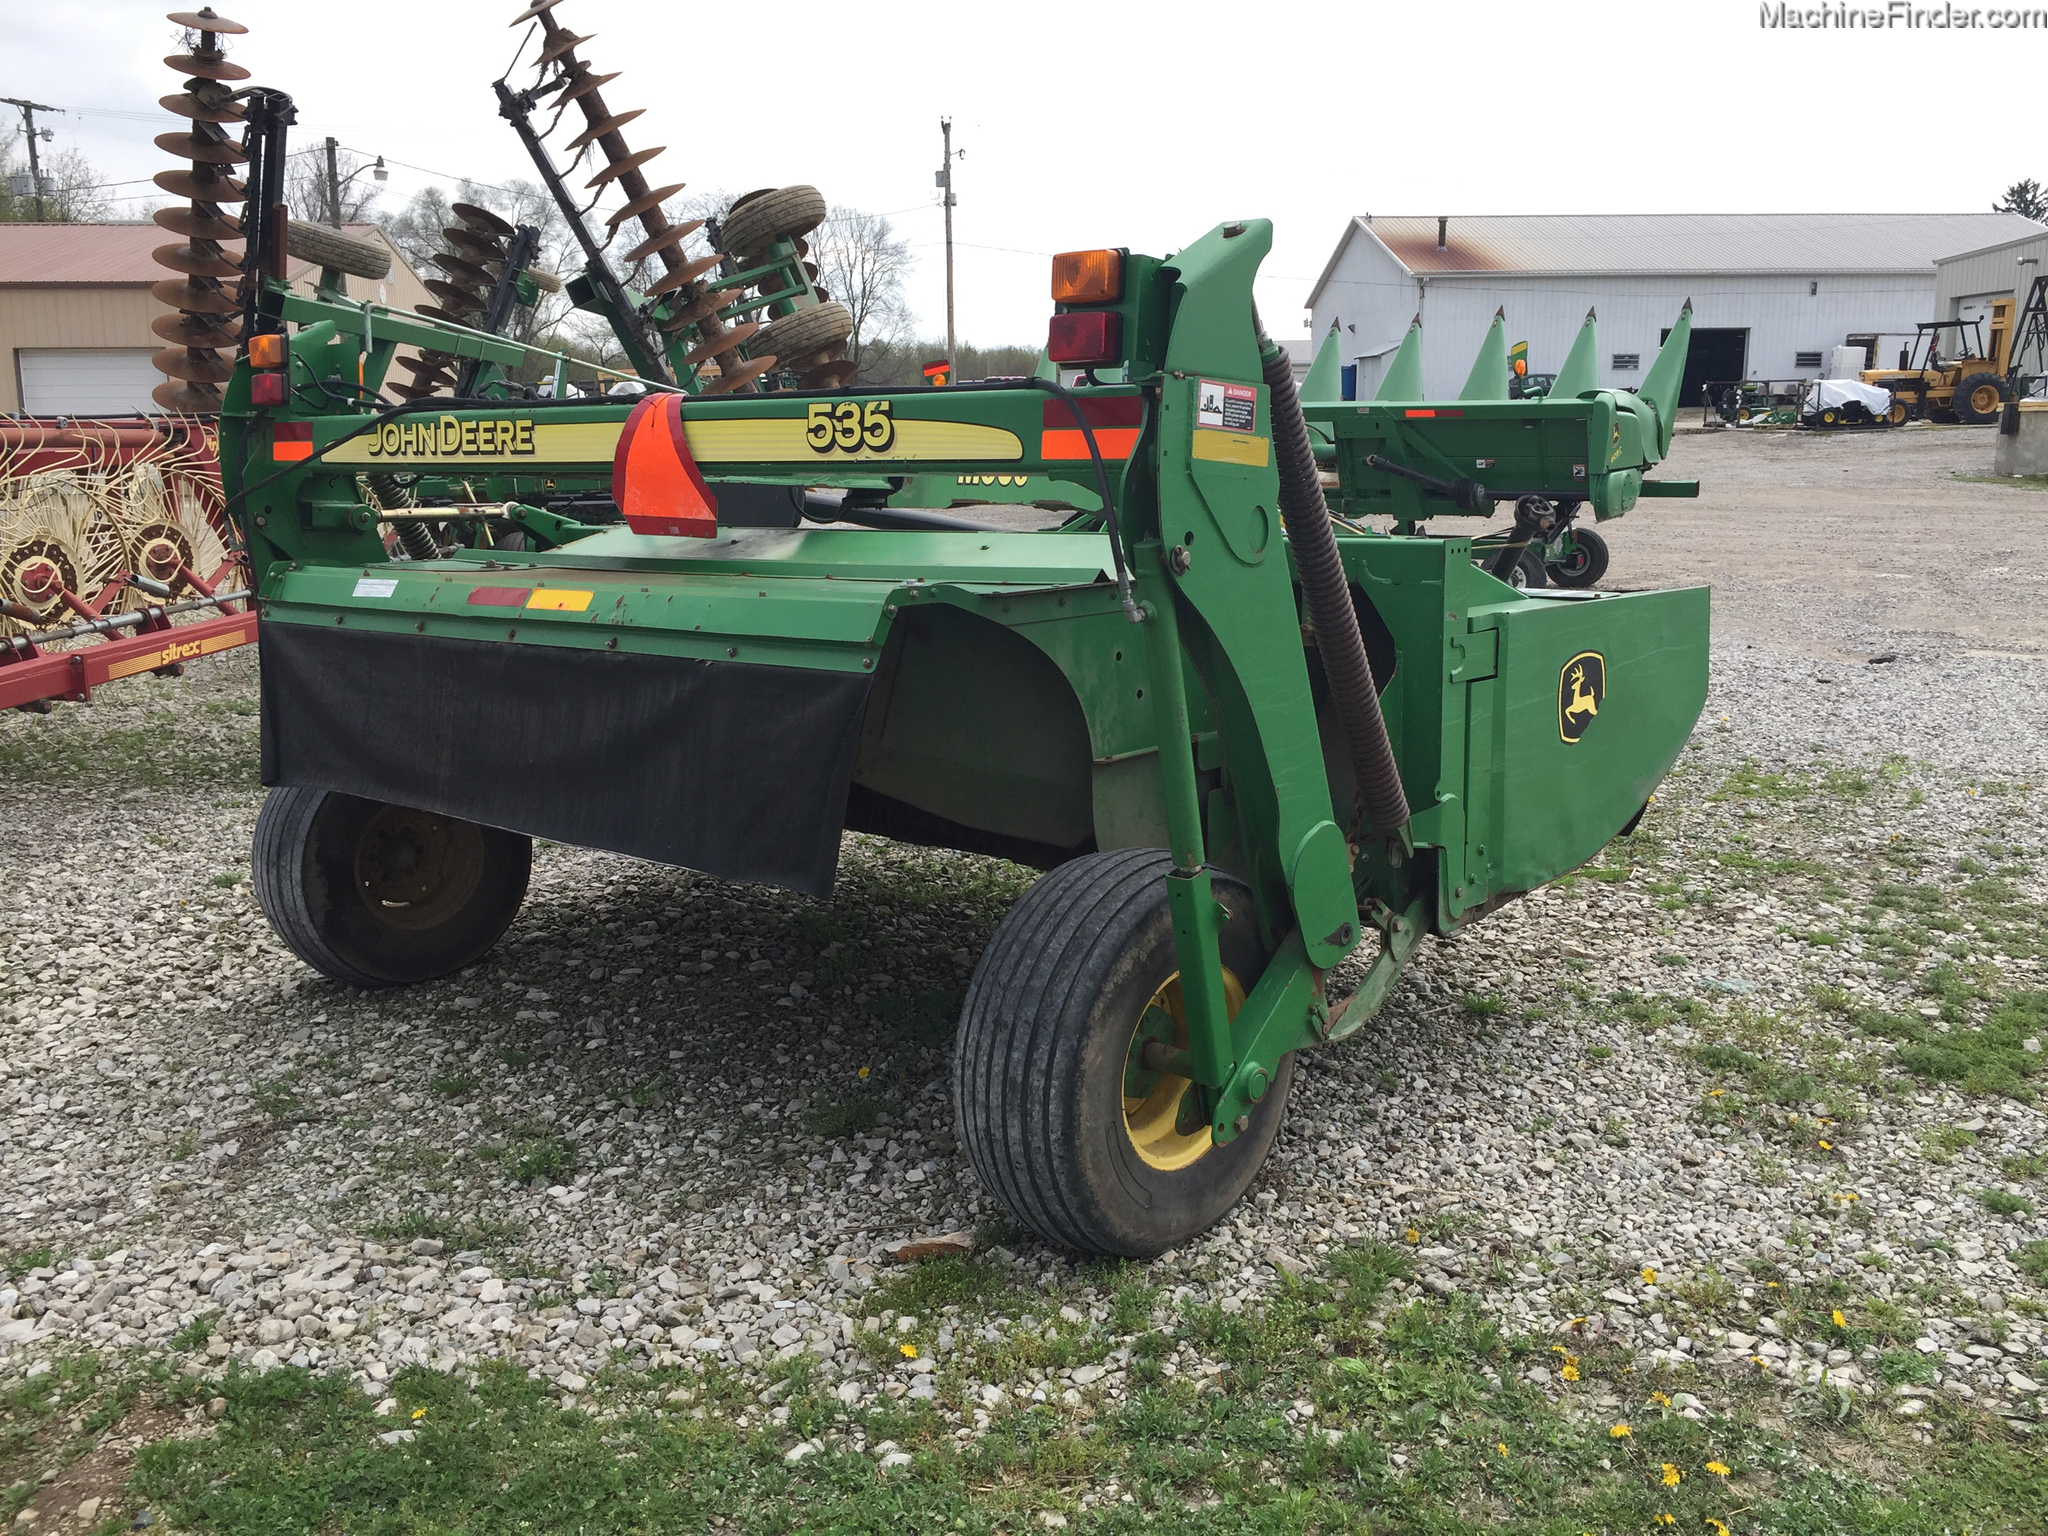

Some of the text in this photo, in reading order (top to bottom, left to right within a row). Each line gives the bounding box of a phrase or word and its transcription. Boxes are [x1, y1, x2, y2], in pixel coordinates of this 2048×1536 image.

[368, 415, 535, 456] JOHN DEERE
[807, 400, 895, 453] 535
[162, 640, 201, 665] sitrex
